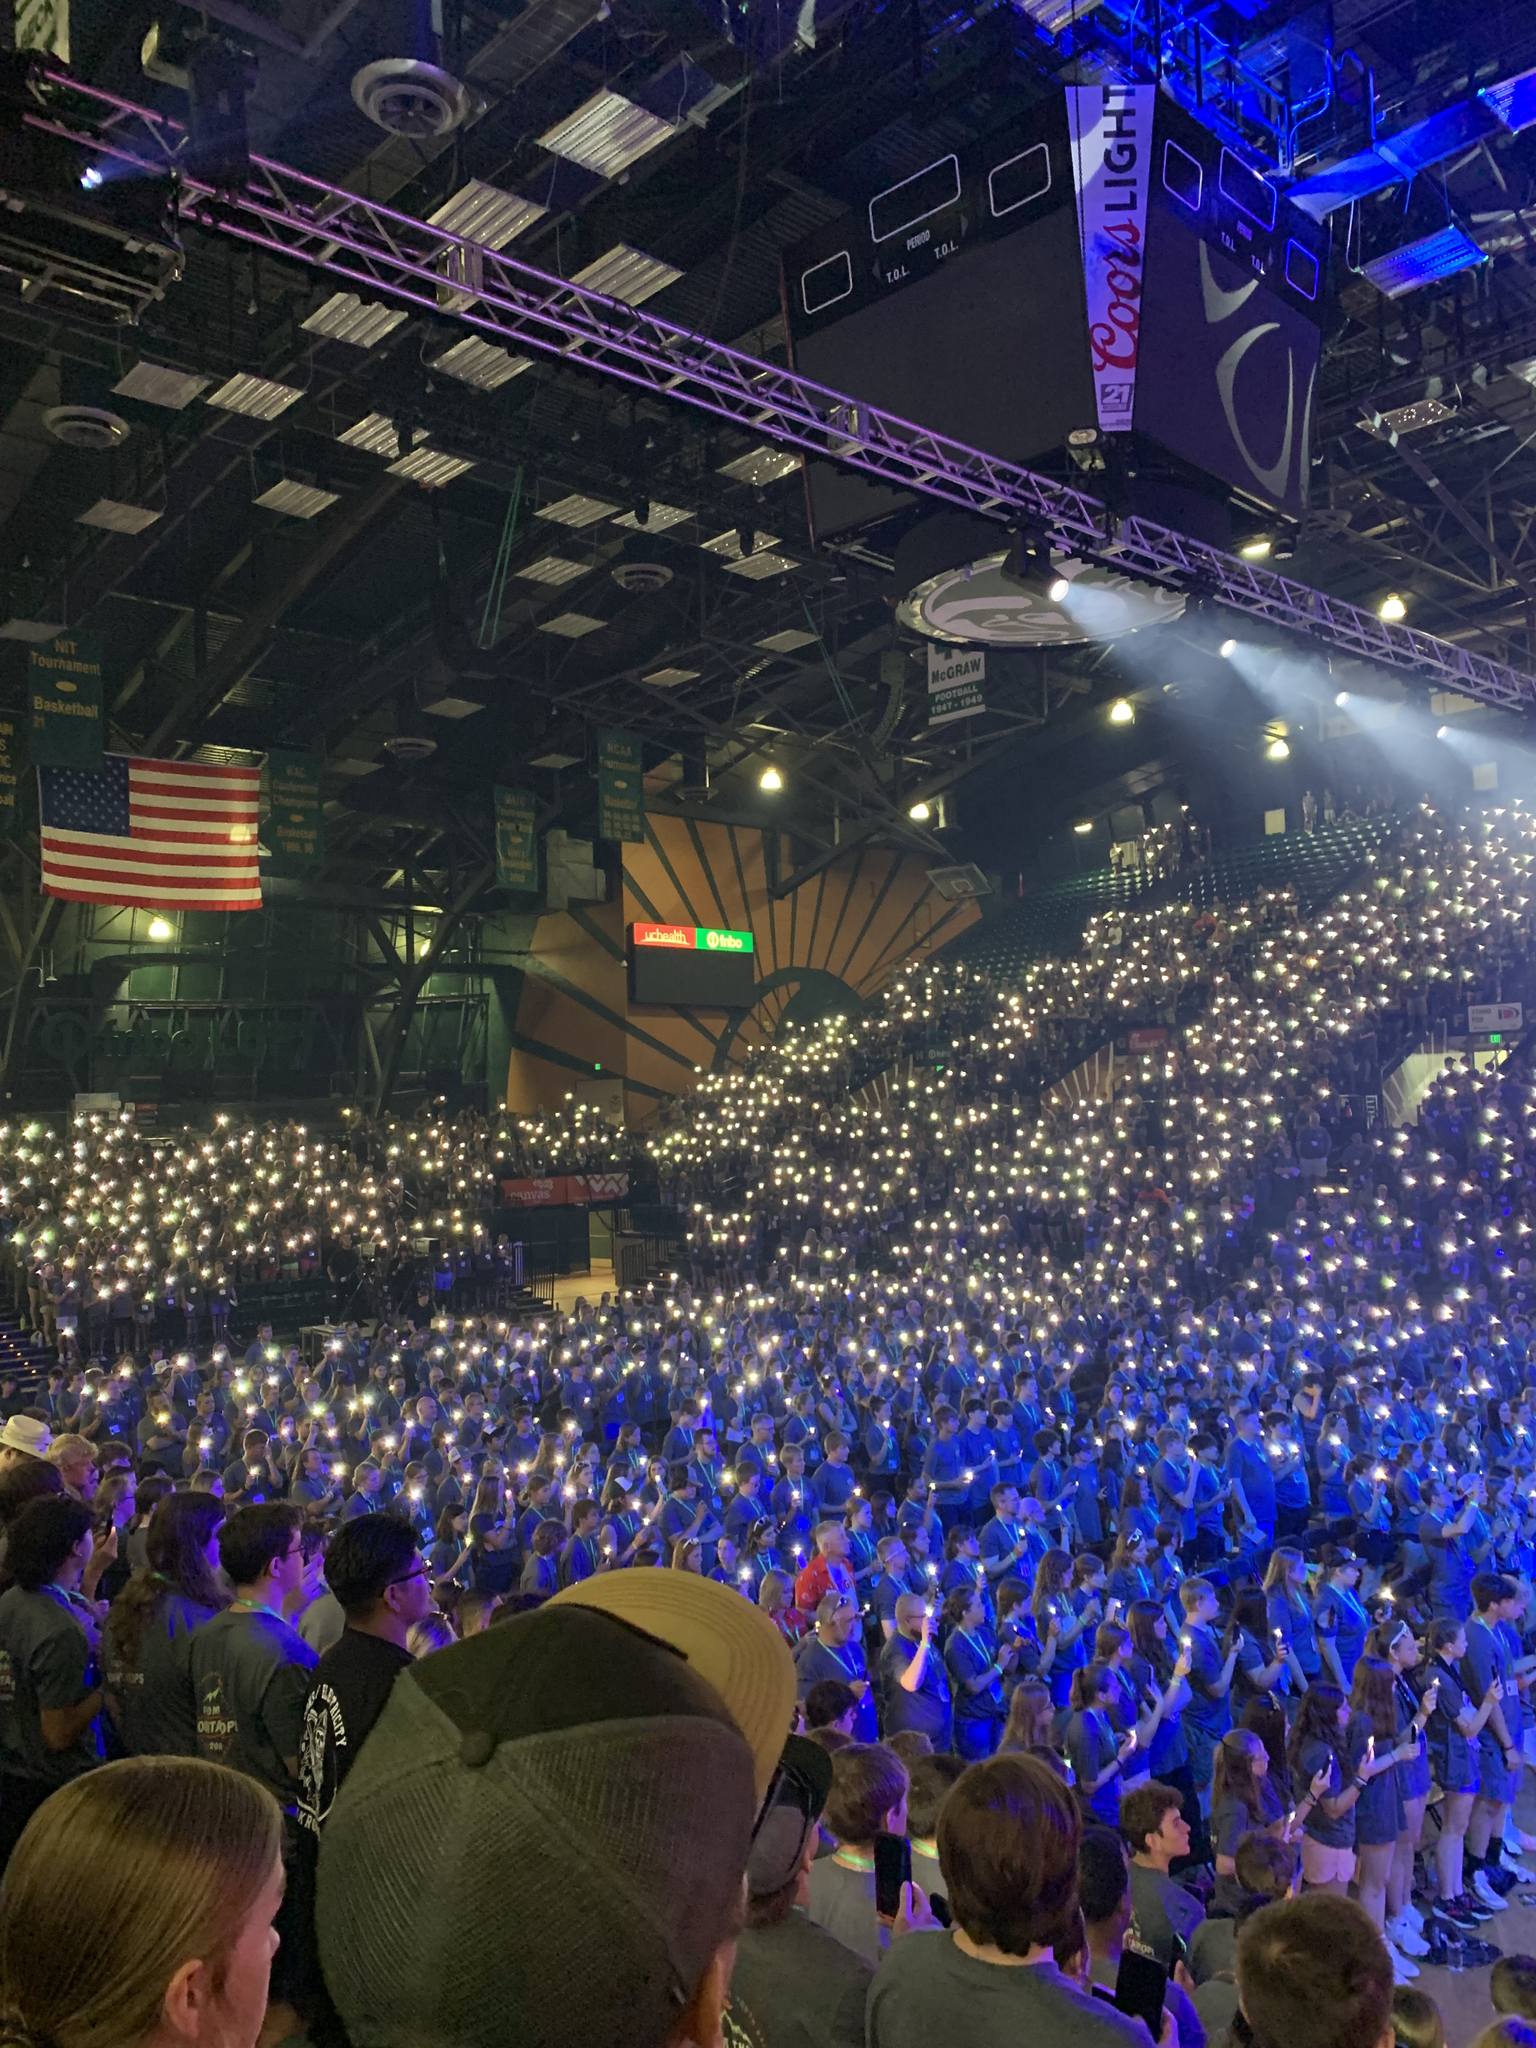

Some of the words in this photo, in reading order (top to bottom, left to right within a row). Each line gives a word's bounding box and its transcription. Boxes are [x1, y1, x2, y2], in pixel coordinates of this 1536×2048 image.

[1102, 84, 1137, 212] LIGHT
[906, 229, 930, 251] PERIOD
[933, 240, 959, 260] T.O.L.
[885, 264, 910, 284] T.O.L.
[1090, 217, 1141, 371] Coors
[1102, 384, 1130, 404] 21
[55, 639, 79, 656] NIT
[31, 650, 102, 675] Tournament
[935, 684, 979, 704] FOOTBALL
[32, 695, 99, 720] Basketball
[509, 1189, 551, 1202] canvas
